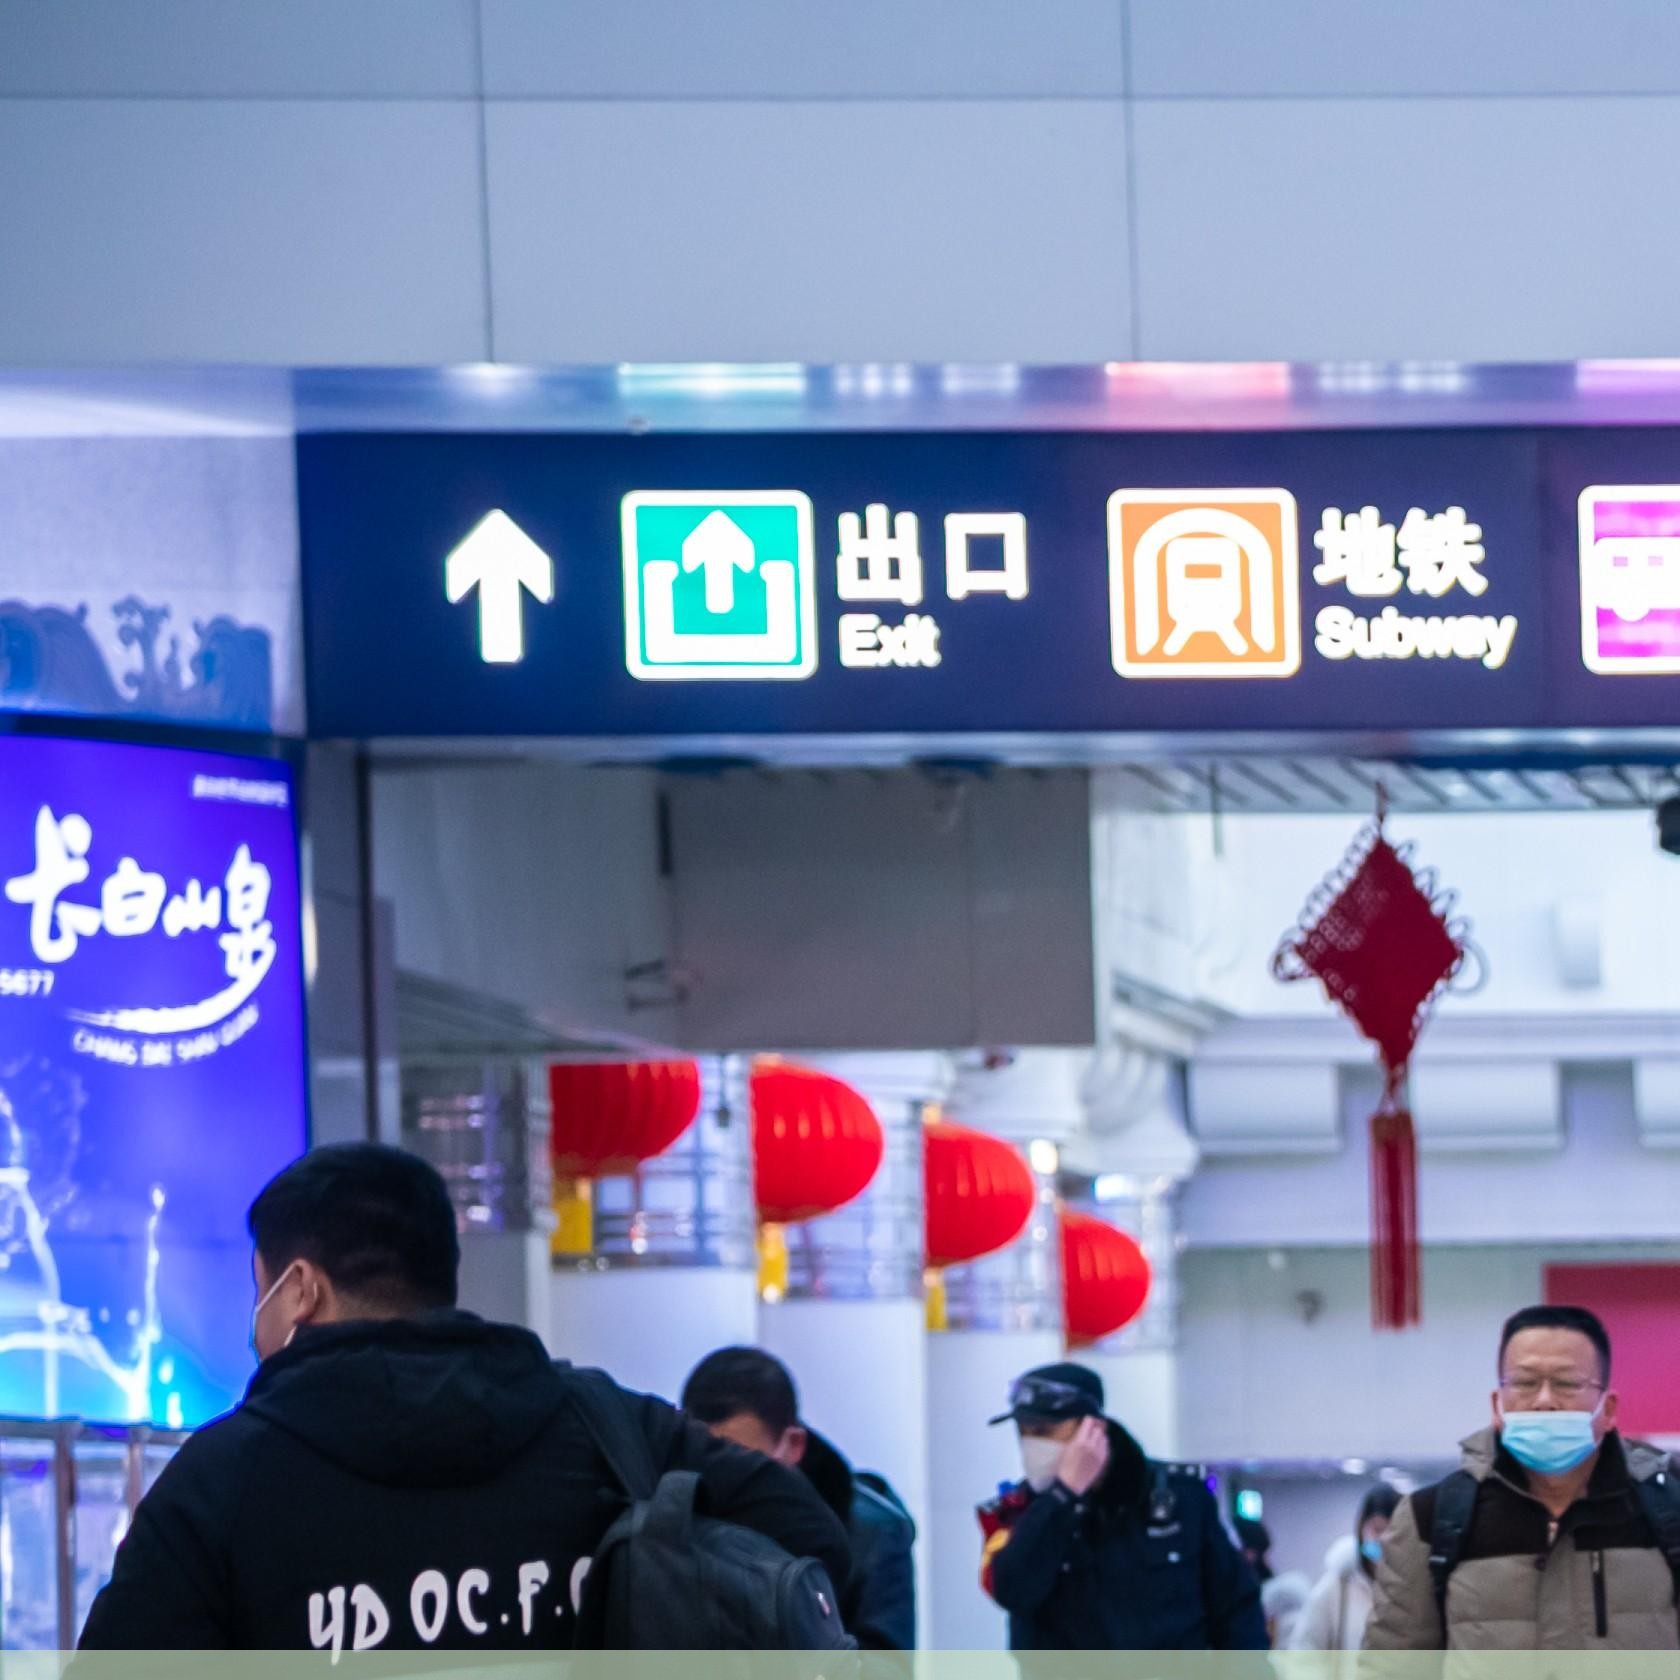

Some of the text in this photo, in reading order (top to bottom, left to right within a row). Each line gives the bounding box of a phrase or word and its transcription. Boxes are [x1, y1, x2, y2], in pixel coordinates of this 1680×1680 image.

[837, 504, 1028, 606] 出口
[1313, 505, 1488, 598] 地铁
[838, 613, 941, 667] Exit
[1314, 605, 1518, 669] Subway
